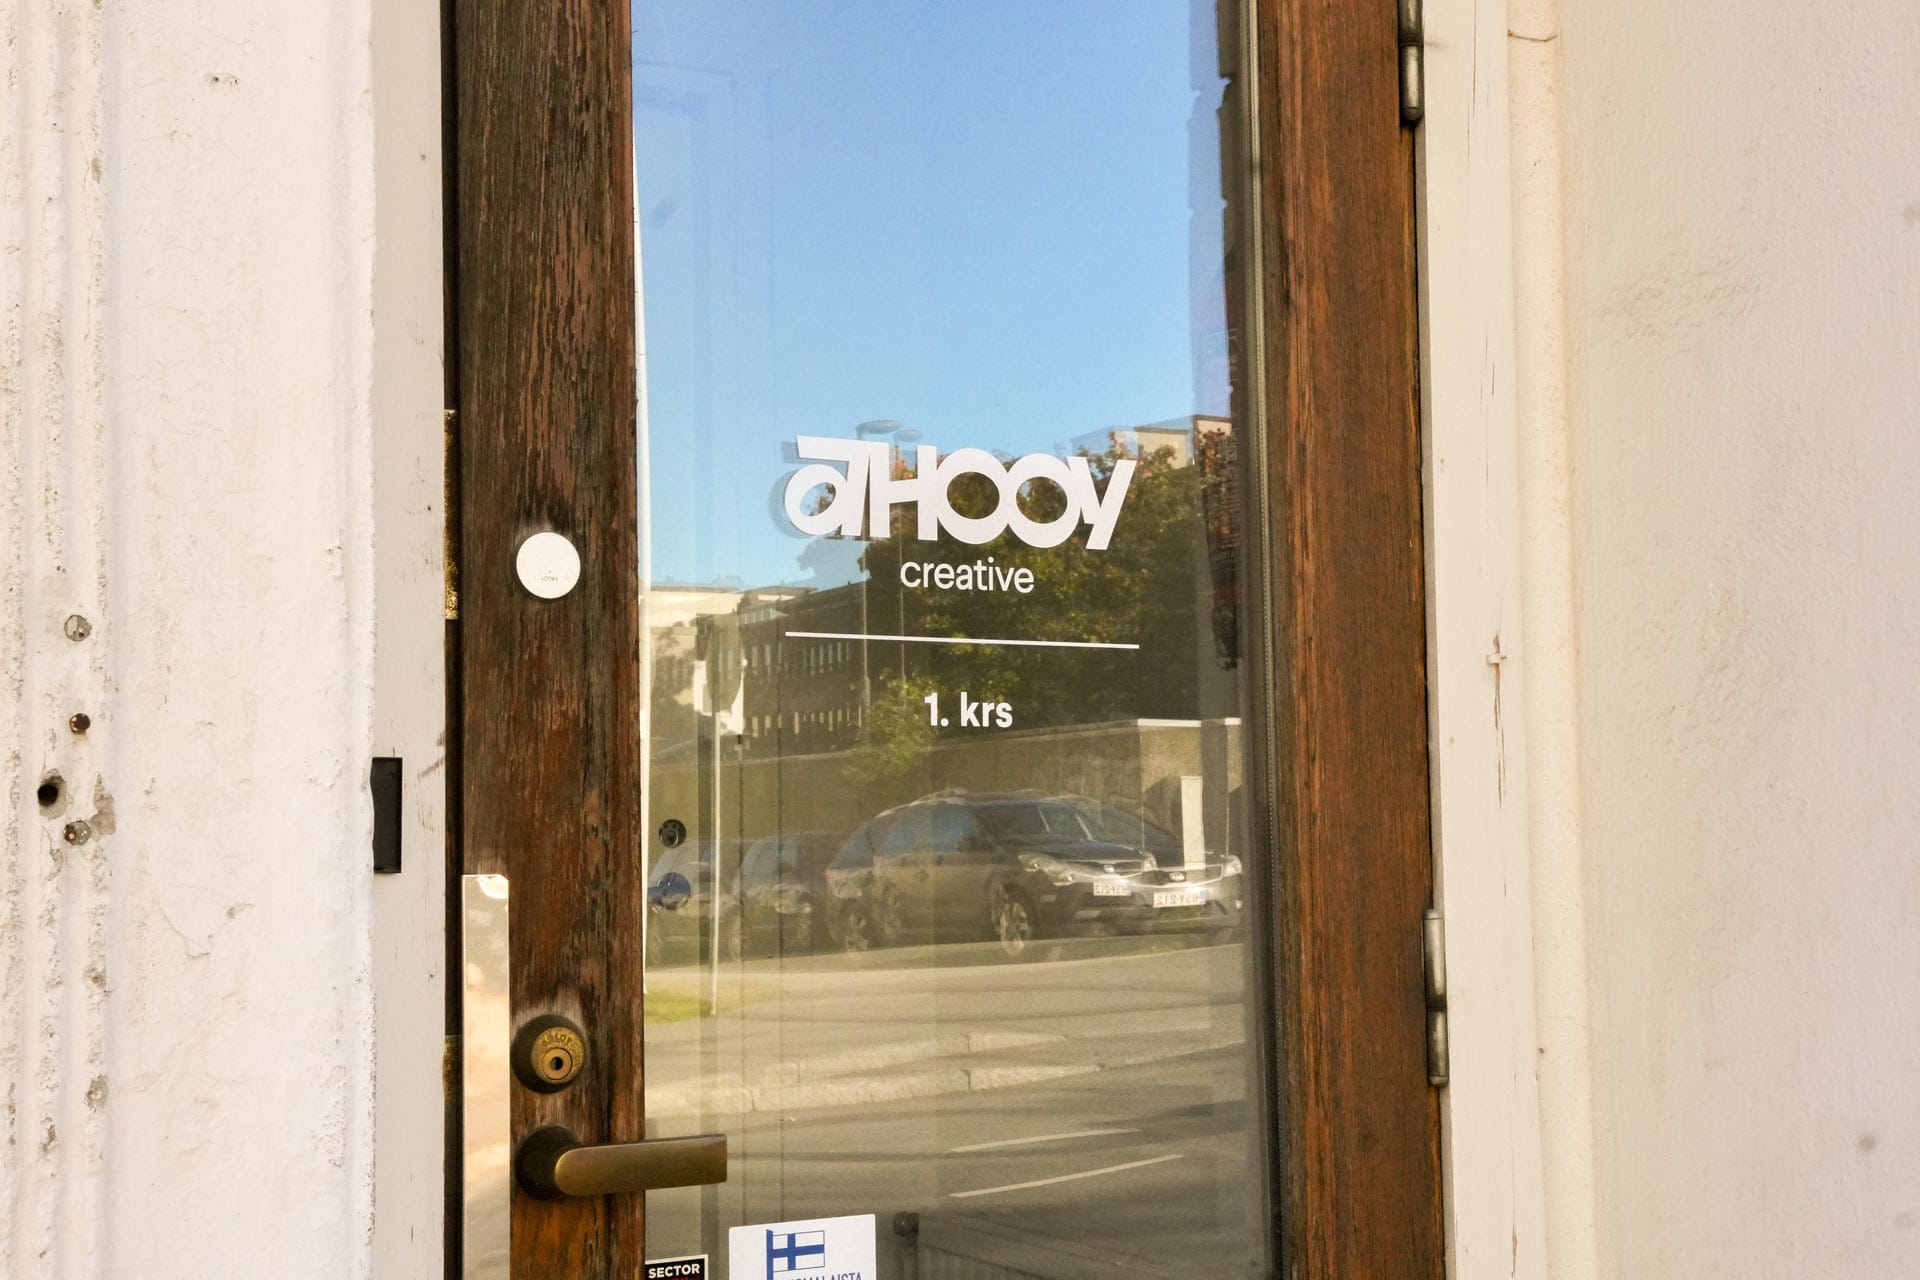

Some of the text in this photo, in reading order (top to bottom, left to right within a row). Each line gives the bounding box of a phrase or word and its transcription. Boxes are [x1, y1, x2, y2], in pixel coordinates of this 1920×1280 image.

[900, 556, 1035, 593] creative
[924, 691, 1013, 728] 1. krs
[648, 1263, 701, 1279] SECTOR
